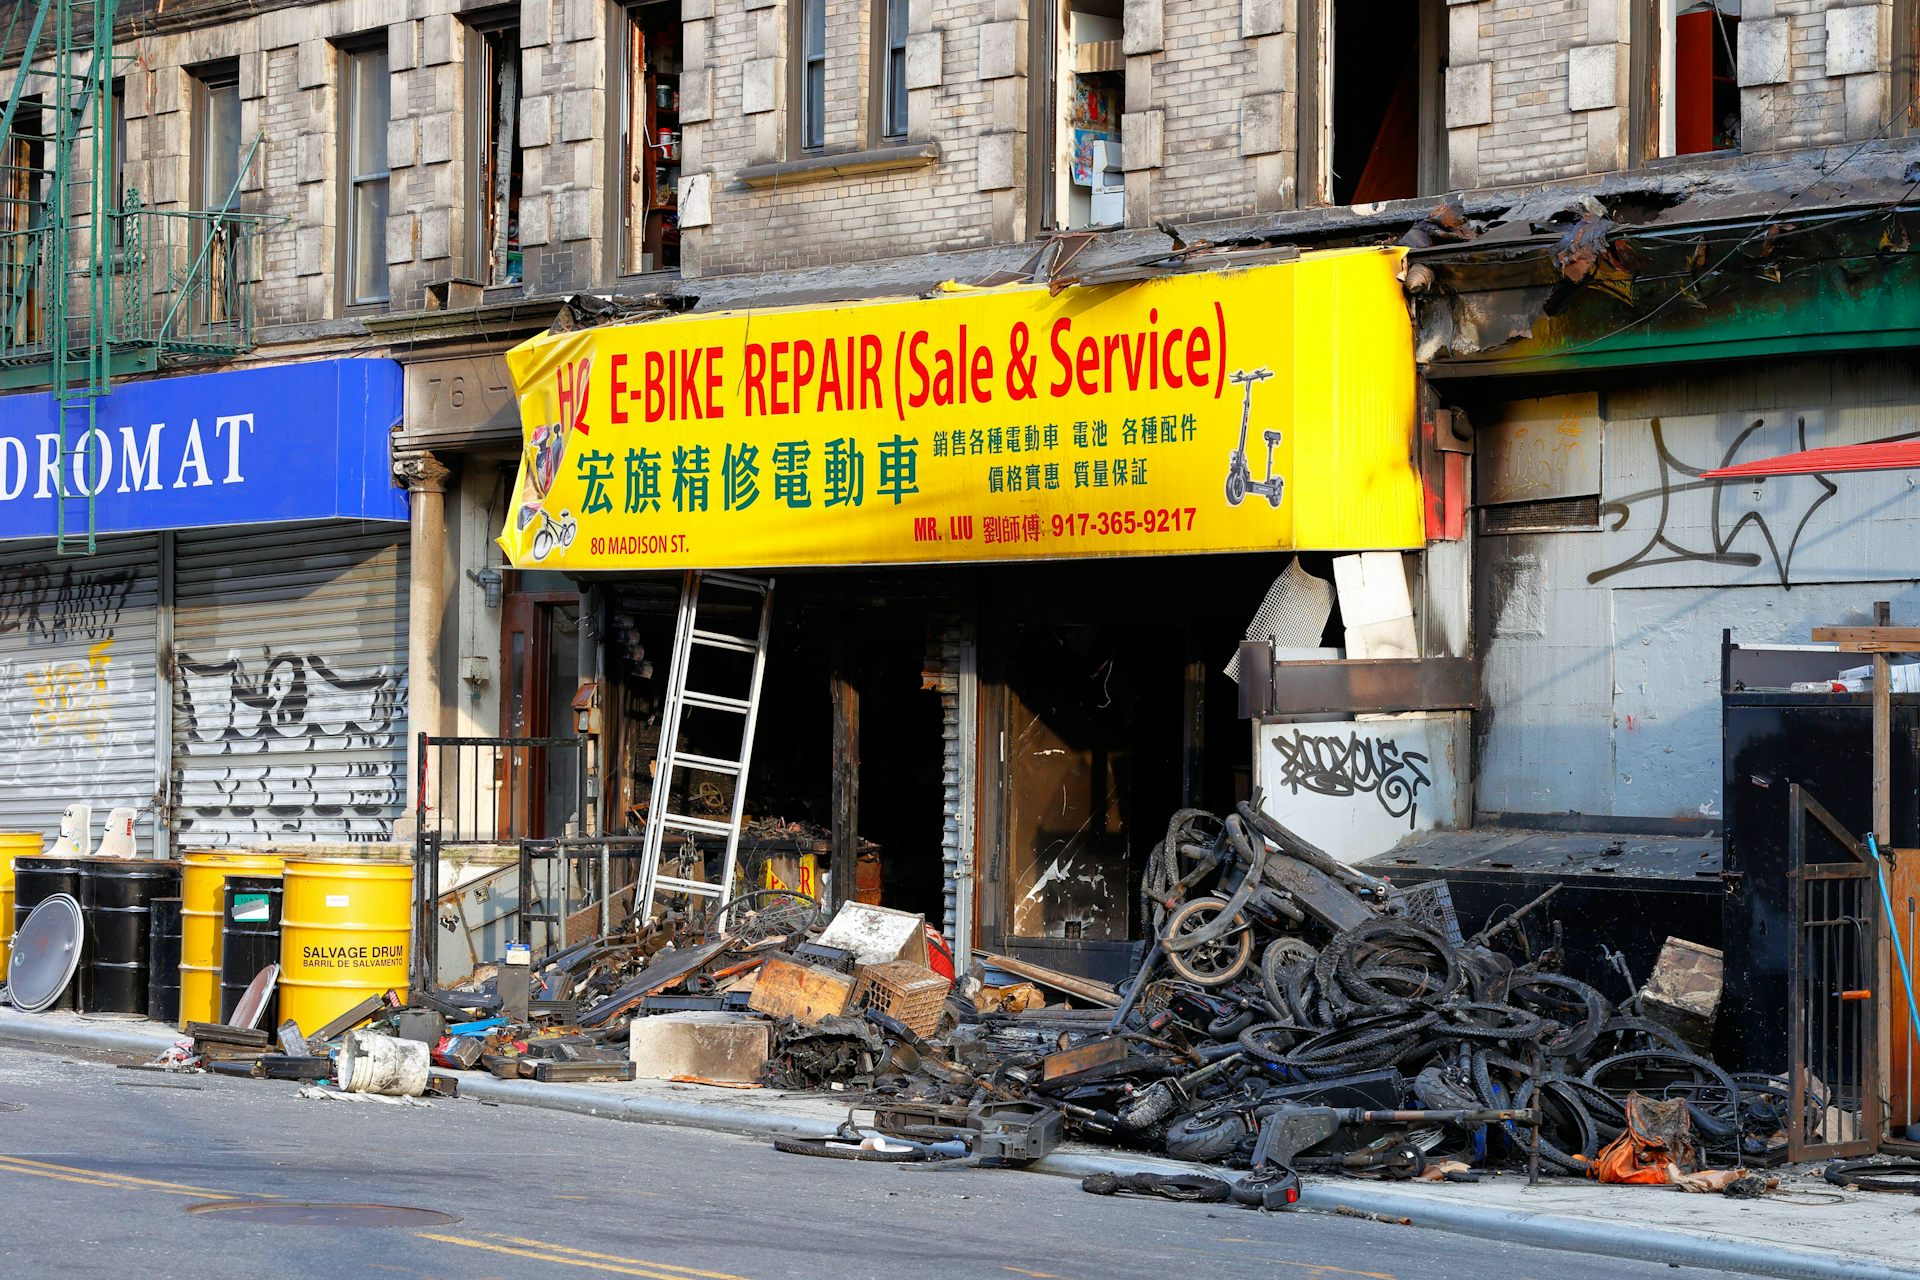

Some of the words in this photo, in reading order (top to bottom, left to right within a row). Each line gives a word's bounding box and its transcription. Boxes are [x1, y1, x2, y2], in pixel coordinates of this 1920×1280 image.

[556, 357, 591, 436] HQ
[611, 346, 725, 424] E-BIKE
[744, 333, 884, 417] REPAIR
[894, 324, 994, 421] (Sale
[1005, 321, 1038, 402] &
[1050, 301, 1227, 399] Service)
[428, 376, 465, 414] 76
[933, 423, 1059, 457] 銷售各種電動車
[1072, 420, 1108, 448] 電池
[1122, 413, 1197, 446] 各種配件
[0, 413, 254, 501] DROMAT
[577, 434, 920, 514] 宏旗精修電動車
[988, 462, 1060, 493] 價格實惠
[1074, 457, 1148, 488] 質量保証
[914, 516, 943, 542] MR.
[950, 515, 974, 540] LIU
[1051, 507, 1197, 537] 917-365-9217
[591, 537, 605, 555] 80
[608, 535, 668, 555] MADISON
[671, 534, 690, 553] ST.
[303, 946, 368, 958] SALVAGE
[372, 945, 403, 958] DRUM
[303, 959, 334, 968] BARRIL
[337, 959, 350, 968] DE
[352, 957, 403, 968] SALVAMENTO
